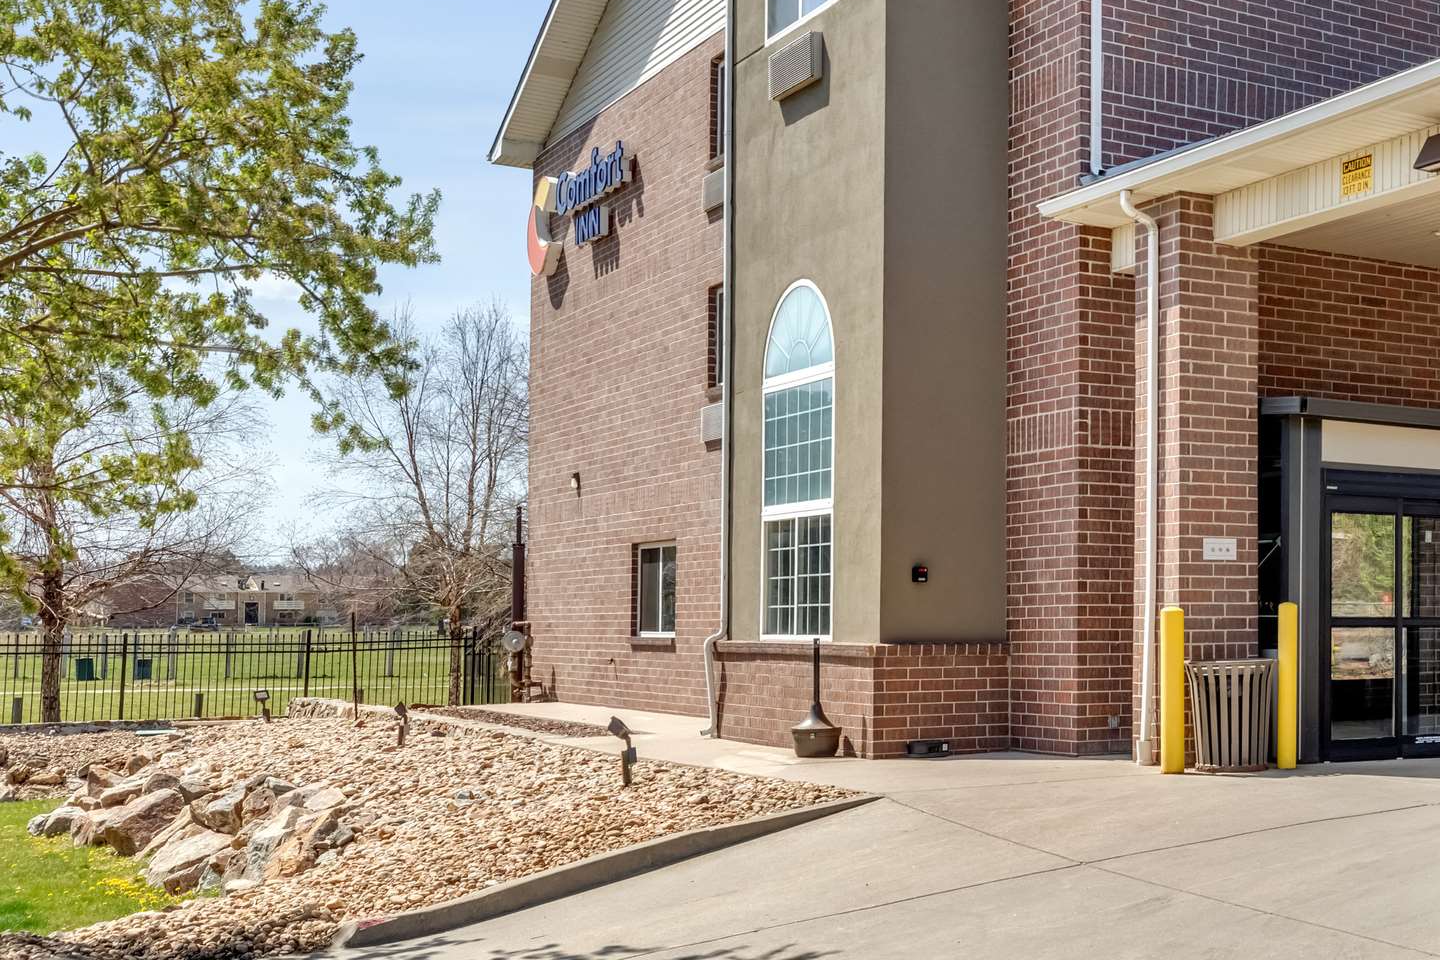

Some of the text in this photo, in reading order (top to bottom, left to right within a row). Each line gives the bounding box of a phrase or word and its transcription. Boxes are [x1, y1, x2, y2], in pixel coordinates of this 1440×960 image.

[556, 140, 623, 216] Comfort
[1342, 169, 1372, 186] CLEARANCE
[1343, 156, 1371, 173] CAUTION
[576, 207, 600, 245] INN
